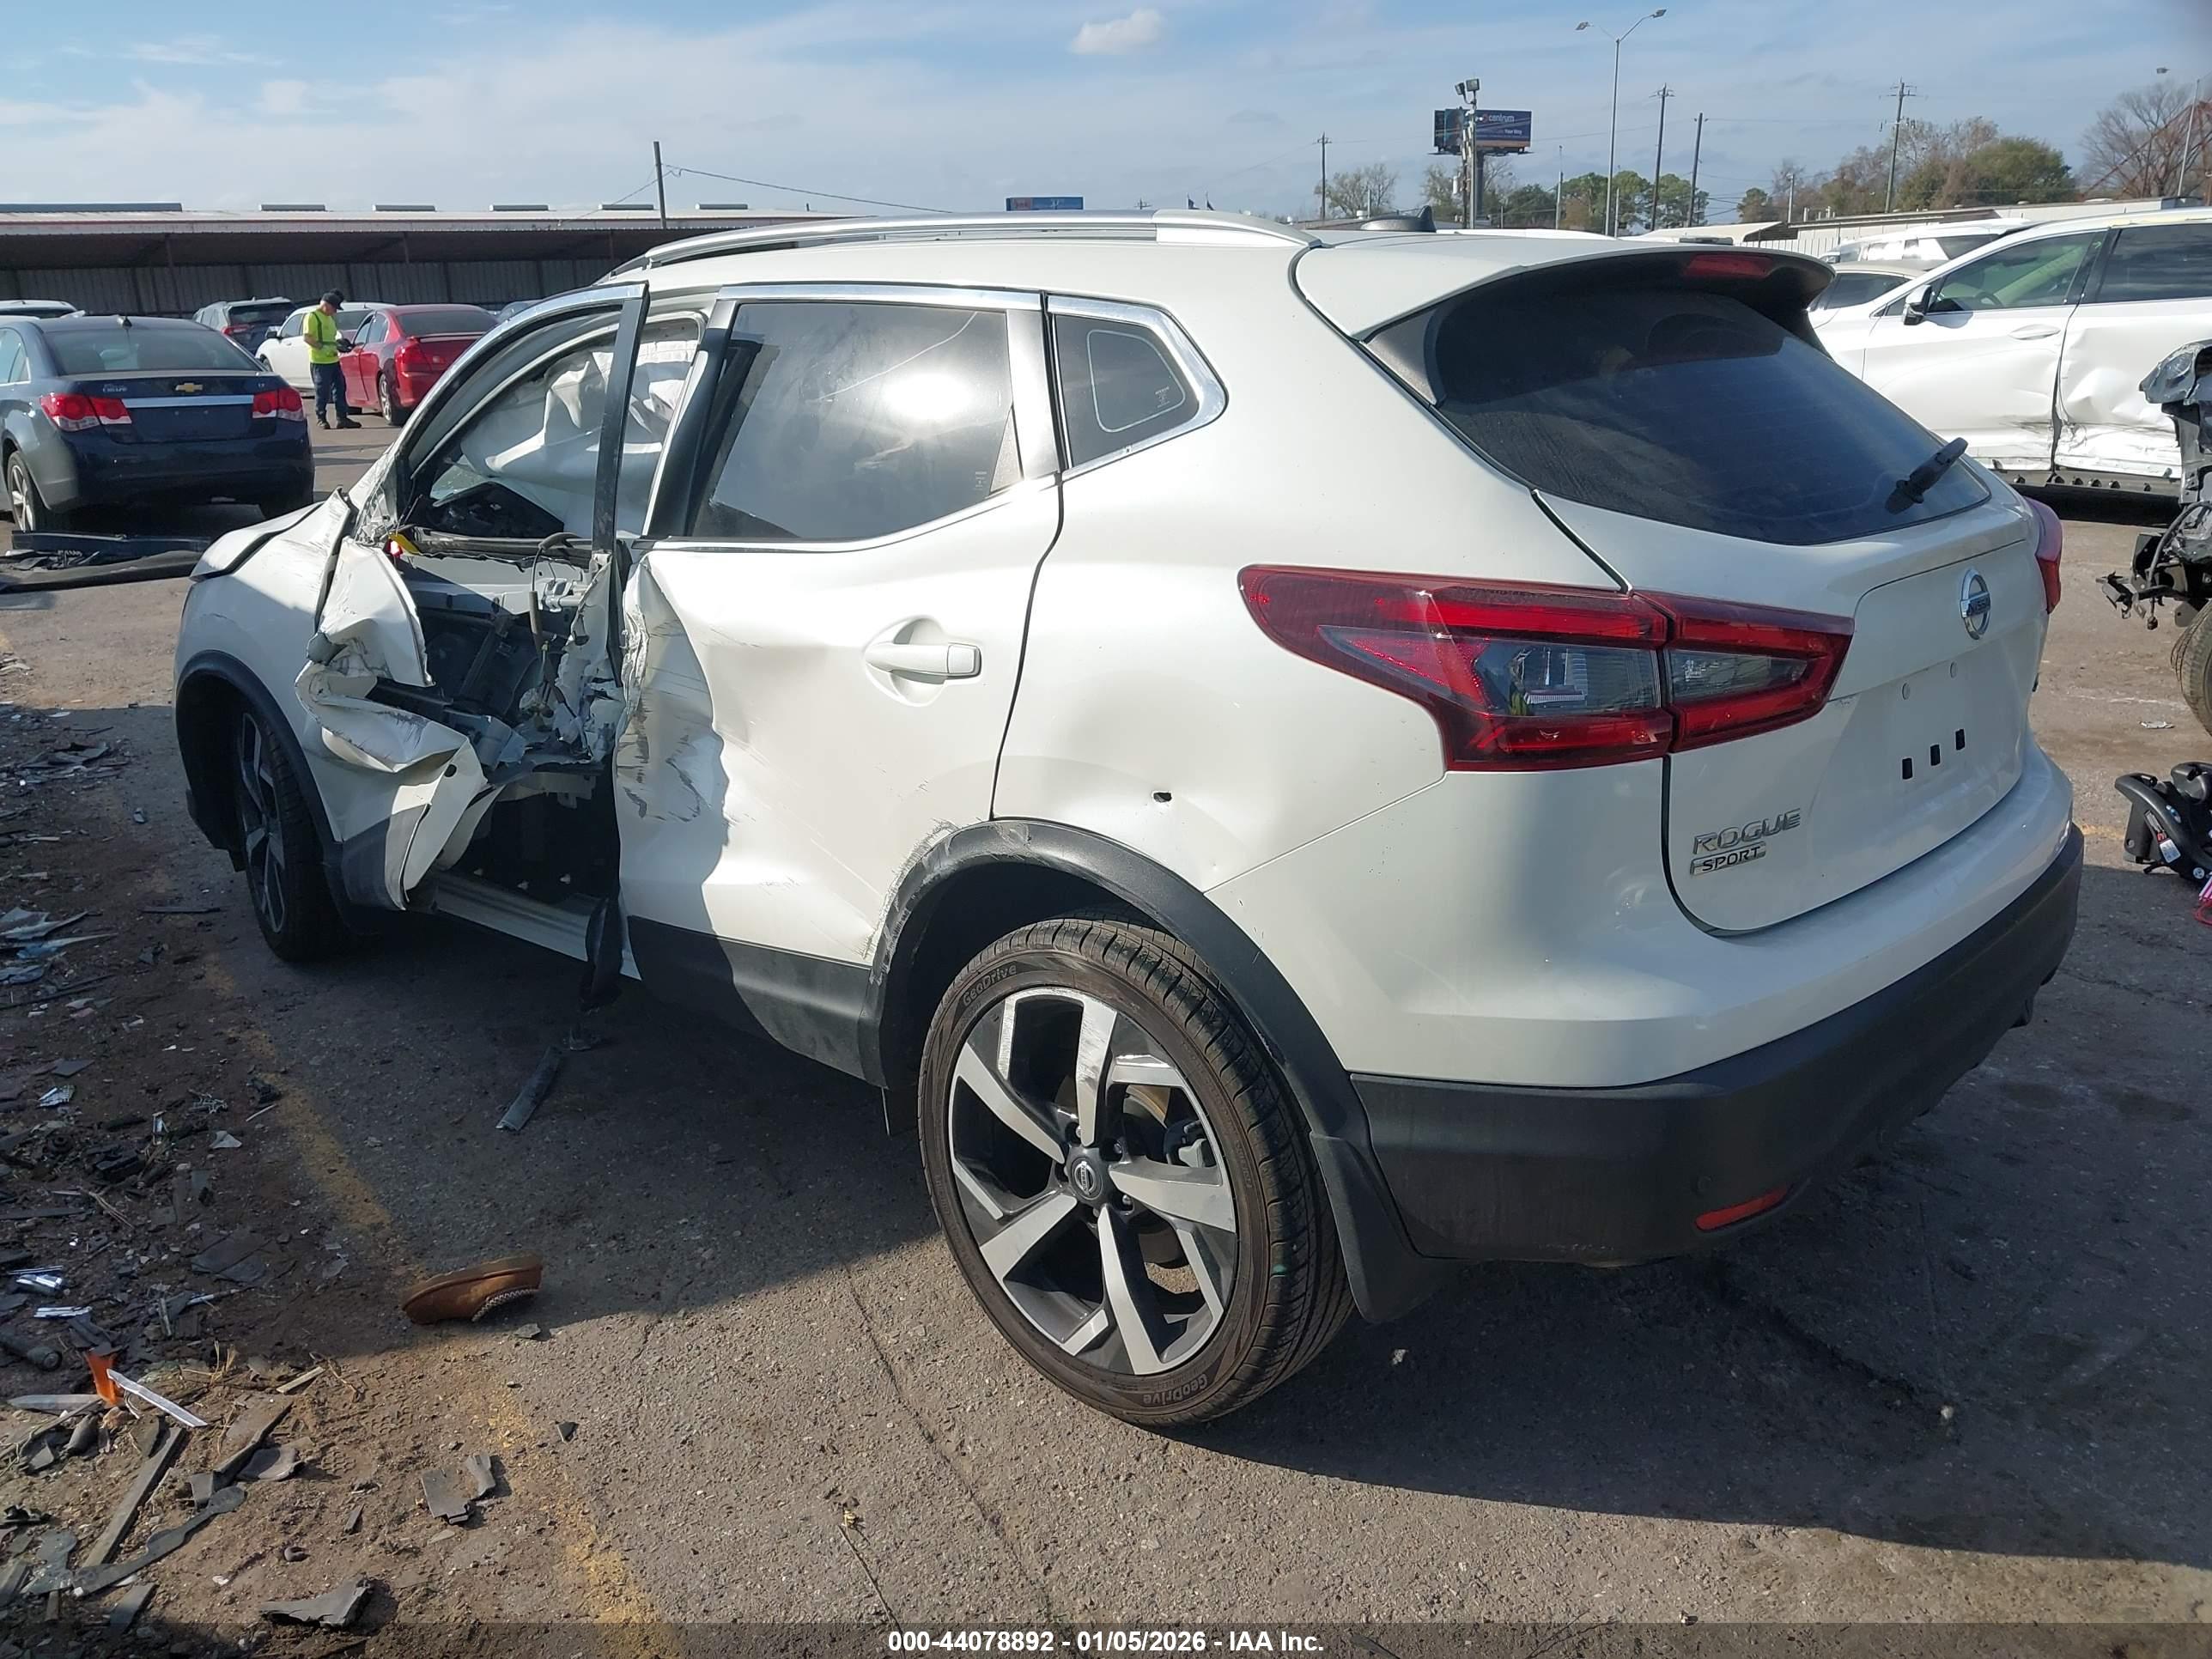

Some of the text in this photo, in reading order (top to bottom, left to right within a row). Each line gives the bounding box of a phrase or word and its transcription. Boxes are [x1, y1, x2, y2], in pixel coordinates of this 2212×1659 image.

[1692, 808, 1801, 854] ROGUE
[1702, 846, 1760, 872] SPORT
[963, 964, 1017, 1006] GeoDrive
[1143, 1373, 1208, 1406] GeoDrive
